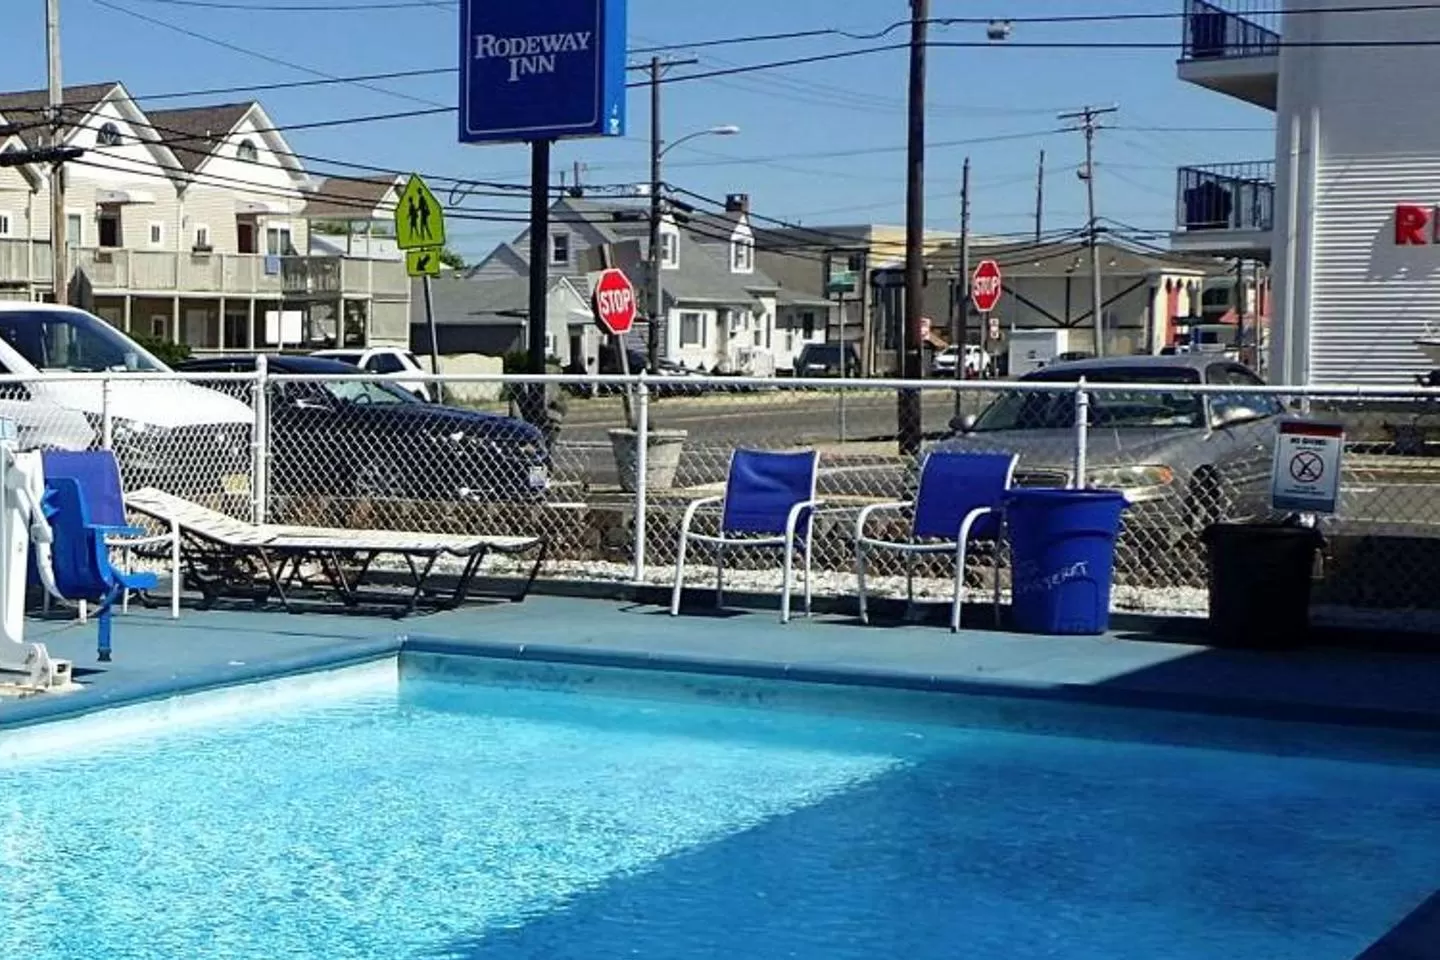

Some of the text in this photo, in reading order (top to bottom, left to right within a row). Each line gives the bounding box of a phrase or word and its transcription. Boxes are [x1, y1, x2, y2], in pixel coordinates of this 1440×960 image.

[474, 31, 591, 59] RODEWAY
[507, 54, 556, 82] INN
[975, 276, 999, 296] STOP
[600, 288, 631, 315] STOP
